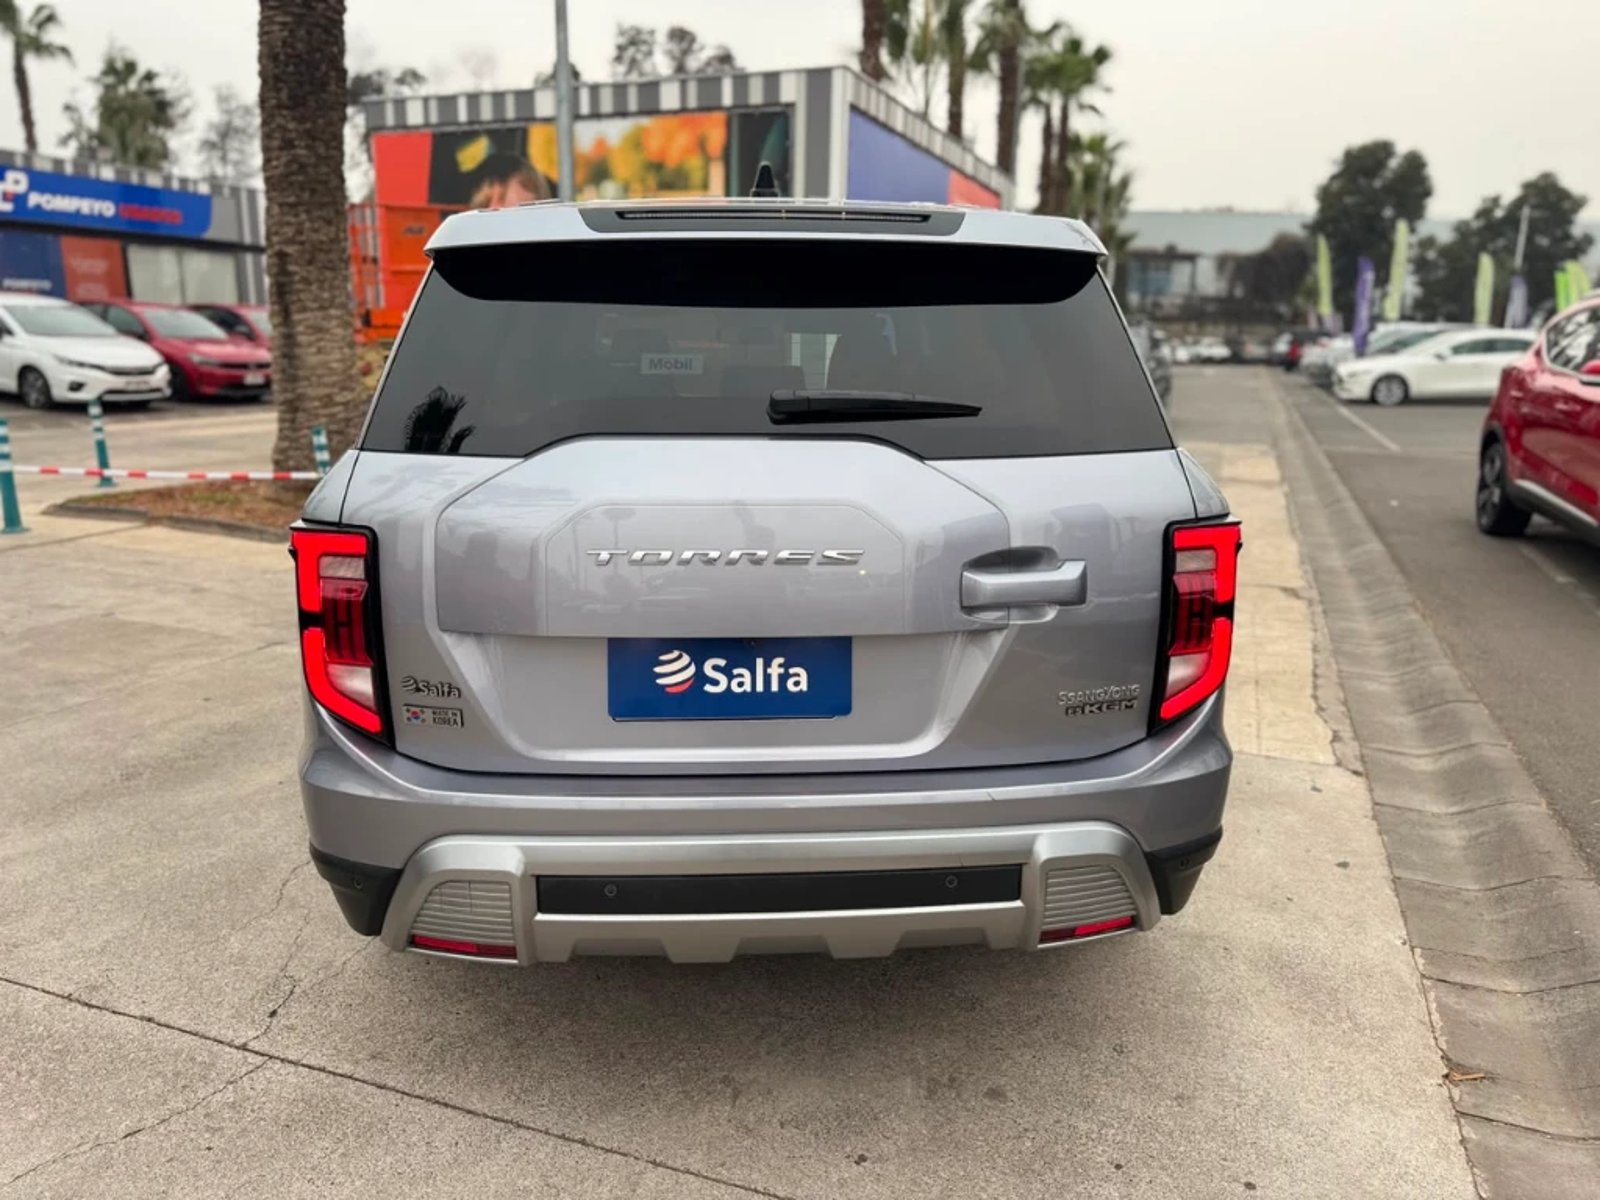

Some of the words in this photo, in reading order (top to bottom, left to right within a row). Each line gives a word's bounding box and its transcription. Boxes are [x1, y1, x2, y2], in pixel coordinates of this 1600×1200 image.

[27, 191, 116, 218] POMPEYO
[649, 357, 693, 371] Mobil
[586, 548, 865, 567] TORRES
[703, 656, 809, 693] Salfa
[418, 680, 462, 698] Salfa
[1058, 684, 1141, 706] SSANGYONG
[1084, 699, 1138, 715] KGM
[432, 716, 459, 727] KOREA
